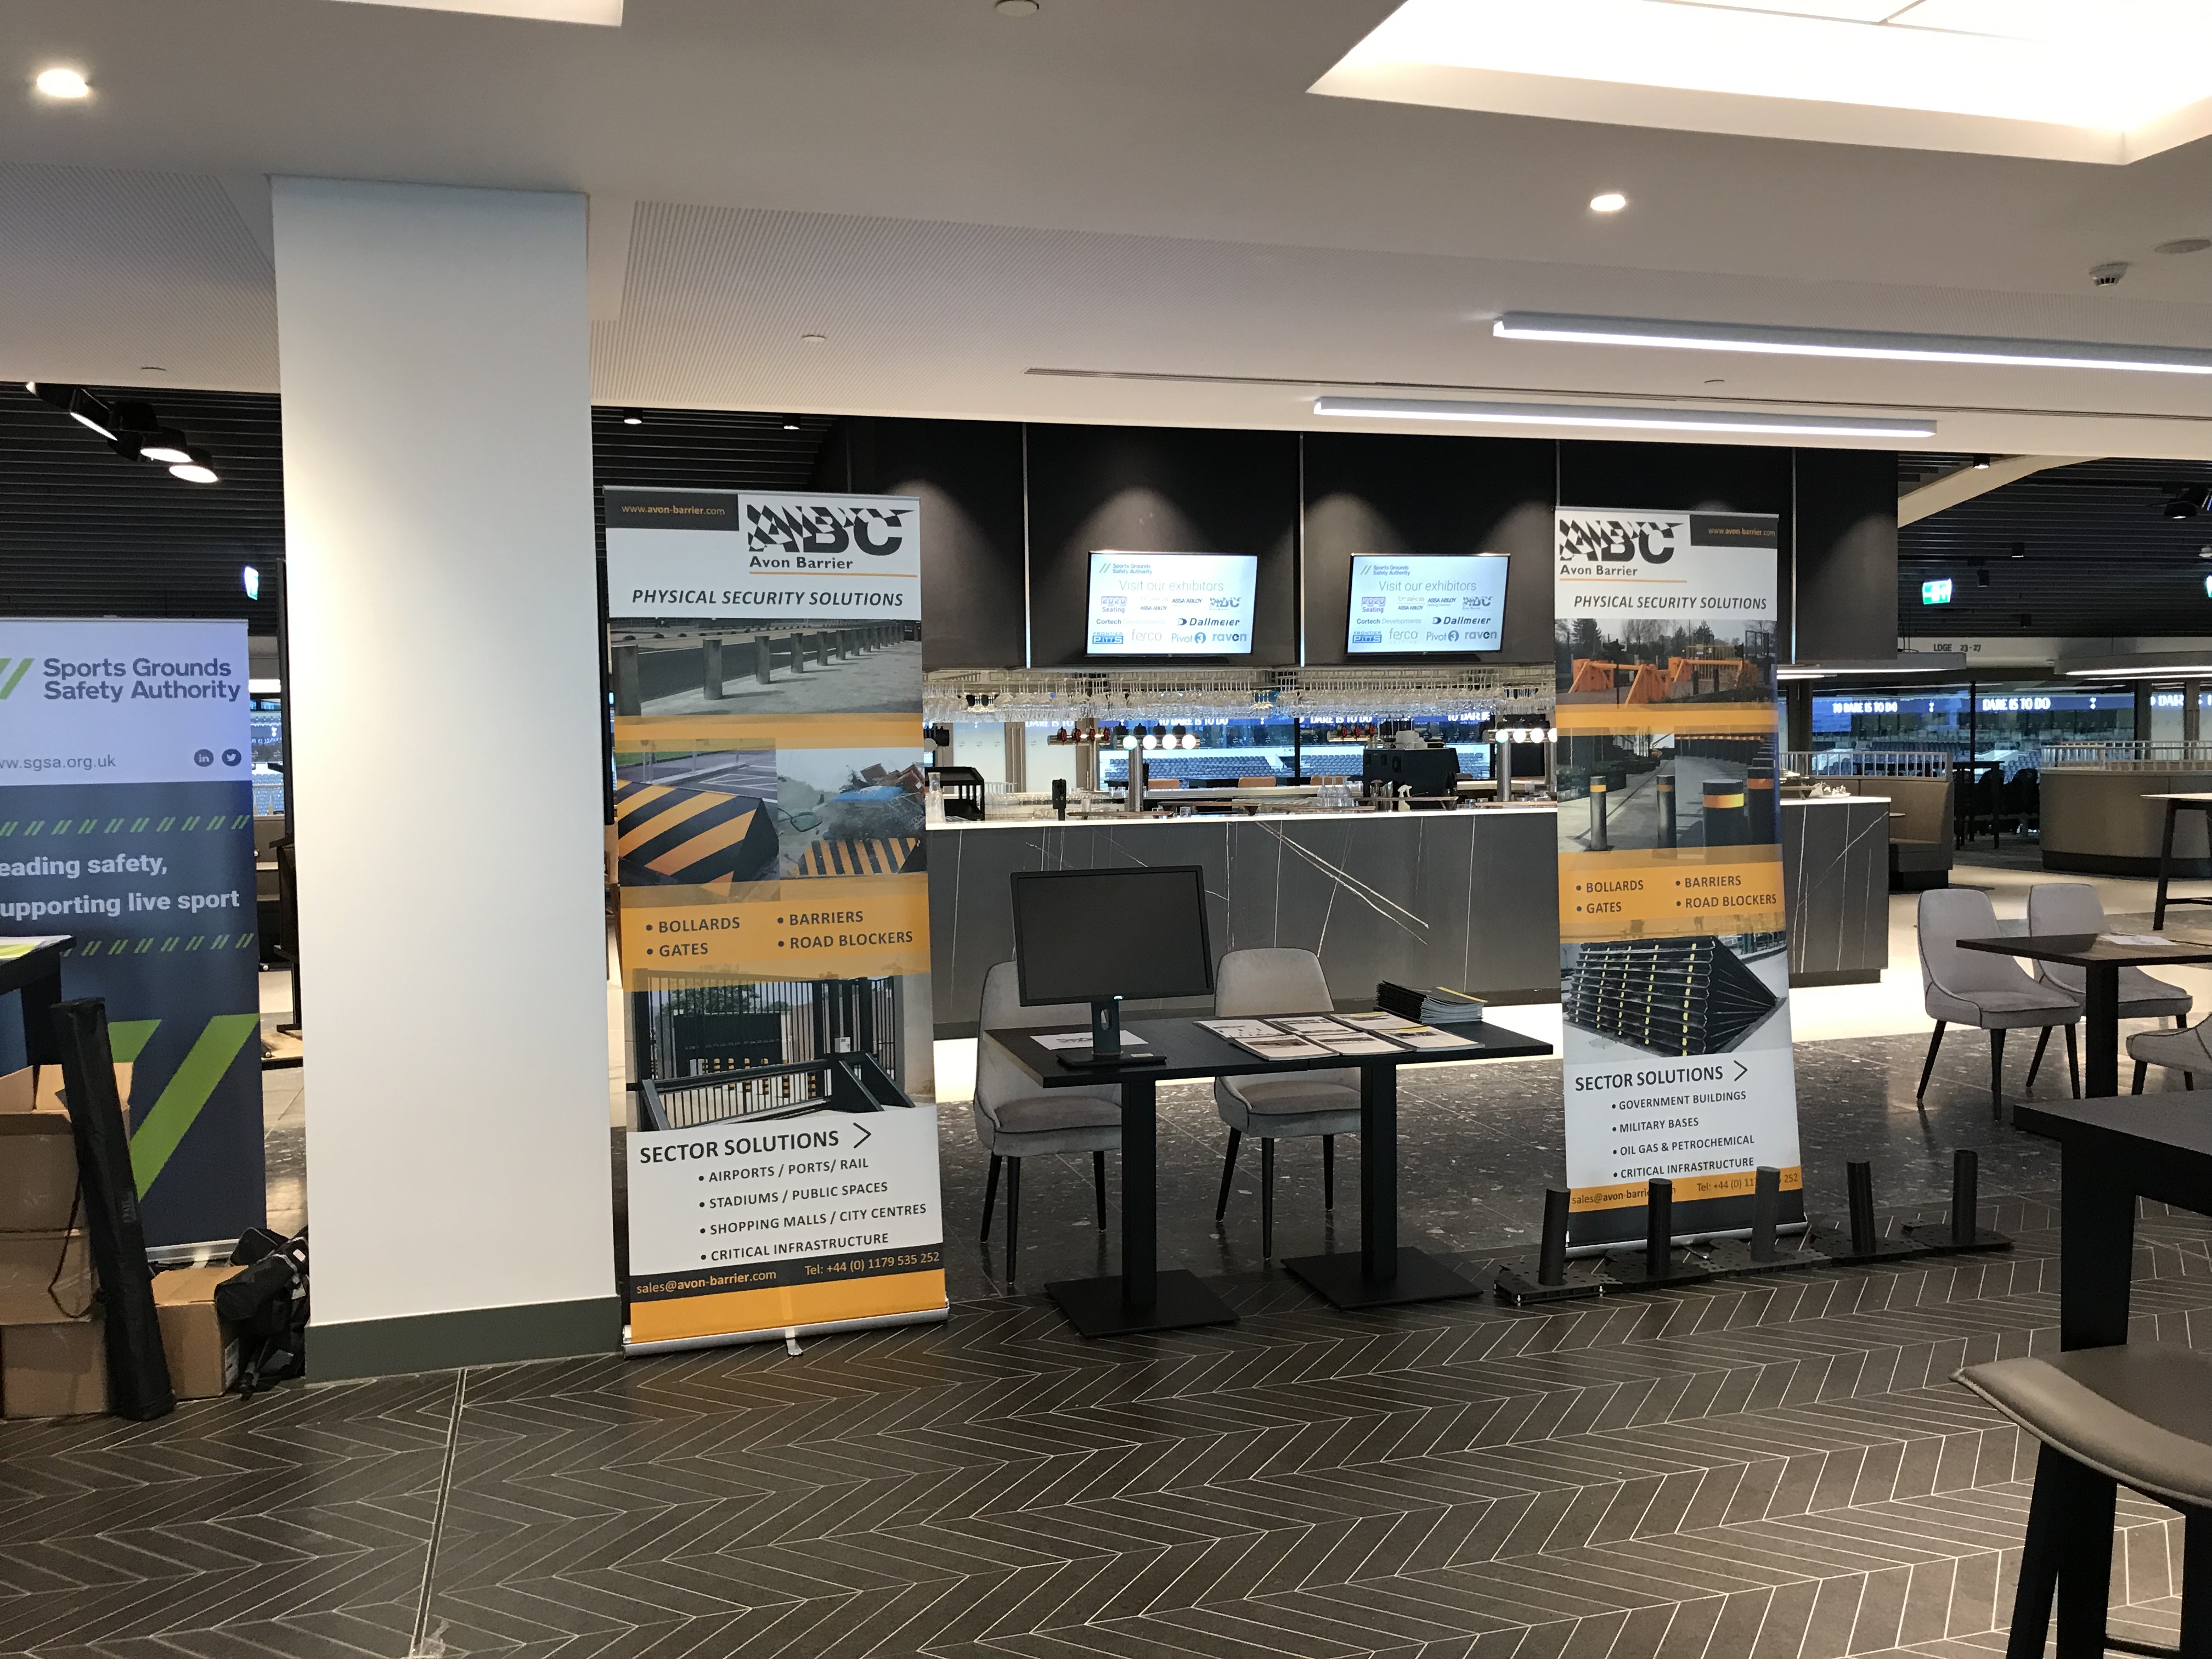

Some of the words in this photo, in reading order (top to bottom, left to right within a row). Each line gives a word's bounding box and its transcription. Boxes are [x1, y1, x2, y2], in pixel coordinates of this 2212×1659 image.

[622, 504, 725, 516] www.avon-barrier.com
[747, 504, 915, 556] ABC
[1559, 519, 1684, 564] ABC
[749, 556, 791, 568] Avon
[797, 557, 854, 569] Barrier
[1560, 565, 1592, 575] Avon
[1596, 566, 1638, 576] Barrier
[1119, 580, 1143, 591] Visit
[1147, 582, 1165, 591] our
[1169, 581, 1224, 591] exhibitors
[1379, 580, 1401, 591] Visit
[1404, 583, 1423, 591] our
[1425, 581, 1476, 591] exhibitors
[632, 589, 716, 604] PHYSICAL
[722, 591, 806, 606] SECURITY
[809, 592, 903, 607] SOLUTIONS
[1574, 596, 1634, 607] PHYSICAL
[1637, 597, 1697, 608] SECURITY
[1700, 597, 1767, 610] SOLUTIONS
[1132, 629, 1162, 641] ferco
[1389, 628, 1418, 640] ferco
[43, 658, 126, 680] Sports
[132, 658, 231, 676] Grounds
[44, 680, 123, 702] Safety
[131, 680, 241, 702] Authority
[1832, 703, 1842, 713] TO
[1865, 702, 1872, 713] IS
[1874, 702, 1884, 713] TO
[1885, 702, 1898, 713] DO
[1983, 698, 2008, 710] DARE
[2008, 698, 2018, 710] IS
[2019, 698, 2033, 710] TO
[2034, 697, 2051, 709] DO
[2158, 695, 2184, 706] DAR
[88, 854, 167, 876] safety,
[1586, 880, 1644, 893] BOLLARDS
[1685, 876, 1741, 888] BARRIERS
[0, 894, 121, 921] upporting
[129, 893, 171, 911] live
[177, 890, 239, 913] sport
[1587, 902, 1622, 914] GATES
[1685, 897, 1718, 908] ROAD
[1723, 894, 1776, 907] BLOCKERS
[659, 917, 740, 933] BOLLARDS
[789, 911, 864, 926] BARRIERS
[790, 935, 833, 949] ROAD
[839, 931, 913, 946] BLOCKERS
[659, 943, 708, 957] GATES
[1575, 1073, 1633, 1092] SECTOR
[1637, 1066, 1723, 1086] SOLUTIONS
[1619, 1095, 1690, 1110] GOVERNMENT
[1693, 1091, 1746, 1104] BUILDINGS
[1620, 1120, 1665, 1133] MILITARY
[1668, 1118, 1699, 1128] BASES
[640, 1141, 718, 1164] SECTOR
[724, 1130, 839, 1155] SOLUTIONS
[1620, 1146, 1636, 1155] OIL
[1638, 1144, 1658, 1154] GAS
[1661, 1142, 1669, 1152] &
[1672, 1135, 1754, 1151] PETROCHEMICAL
[708, 1166, 775, 1183] AIRPORTS
[778, 1164, 784, 1178] /
[840, 1158, 869, 1170] RAIL
[1621, 1166, 1664, 1179] CRITICAL
[1667, 1158, 1754, 1174] INFRASTRUCTURE
[709, 1192, 778, 1209] STADIUMS
[782, 1190, 788, 1204] /
[792, 1186, 838, 1201] PUBLIC
[842, 1182, 888, 1196] SPACES
[1572, 1187, 1676, 1205] sales@avon-barri
[1697, 1183, 1711, 1192] Tel:
[1731, 1180, 1742, 1189] (0)
[1745, 1178, 1757, 1187] 11
[1784, 1173, 1798, 1183] 252
[709, 1217, 780, 1235] SHOPPING
[783, 1213, 826, 1228] MALLS
[830, 1211, 836, 1224] /
[839, 1209, 867, 1222] CITY
[871, 1203, 926, 1218] CENTRES
[711, 1244, 770, 1261] CRITICAL
[774, 1233, 889, 1255] INFRASTRUCTURE
[636, 1269, 776, 1294] sales@avon-barrier.com
[805, 1264, 823, 1277] Tel:
[826, 1261, 847, 1273] +44
[850, 1260, 865, 1273] (0)
[868, 1256, 894, 1269] 1179
[897, 1254, 917, 1266] 535
[920, 1251, 940, 1263] 252
